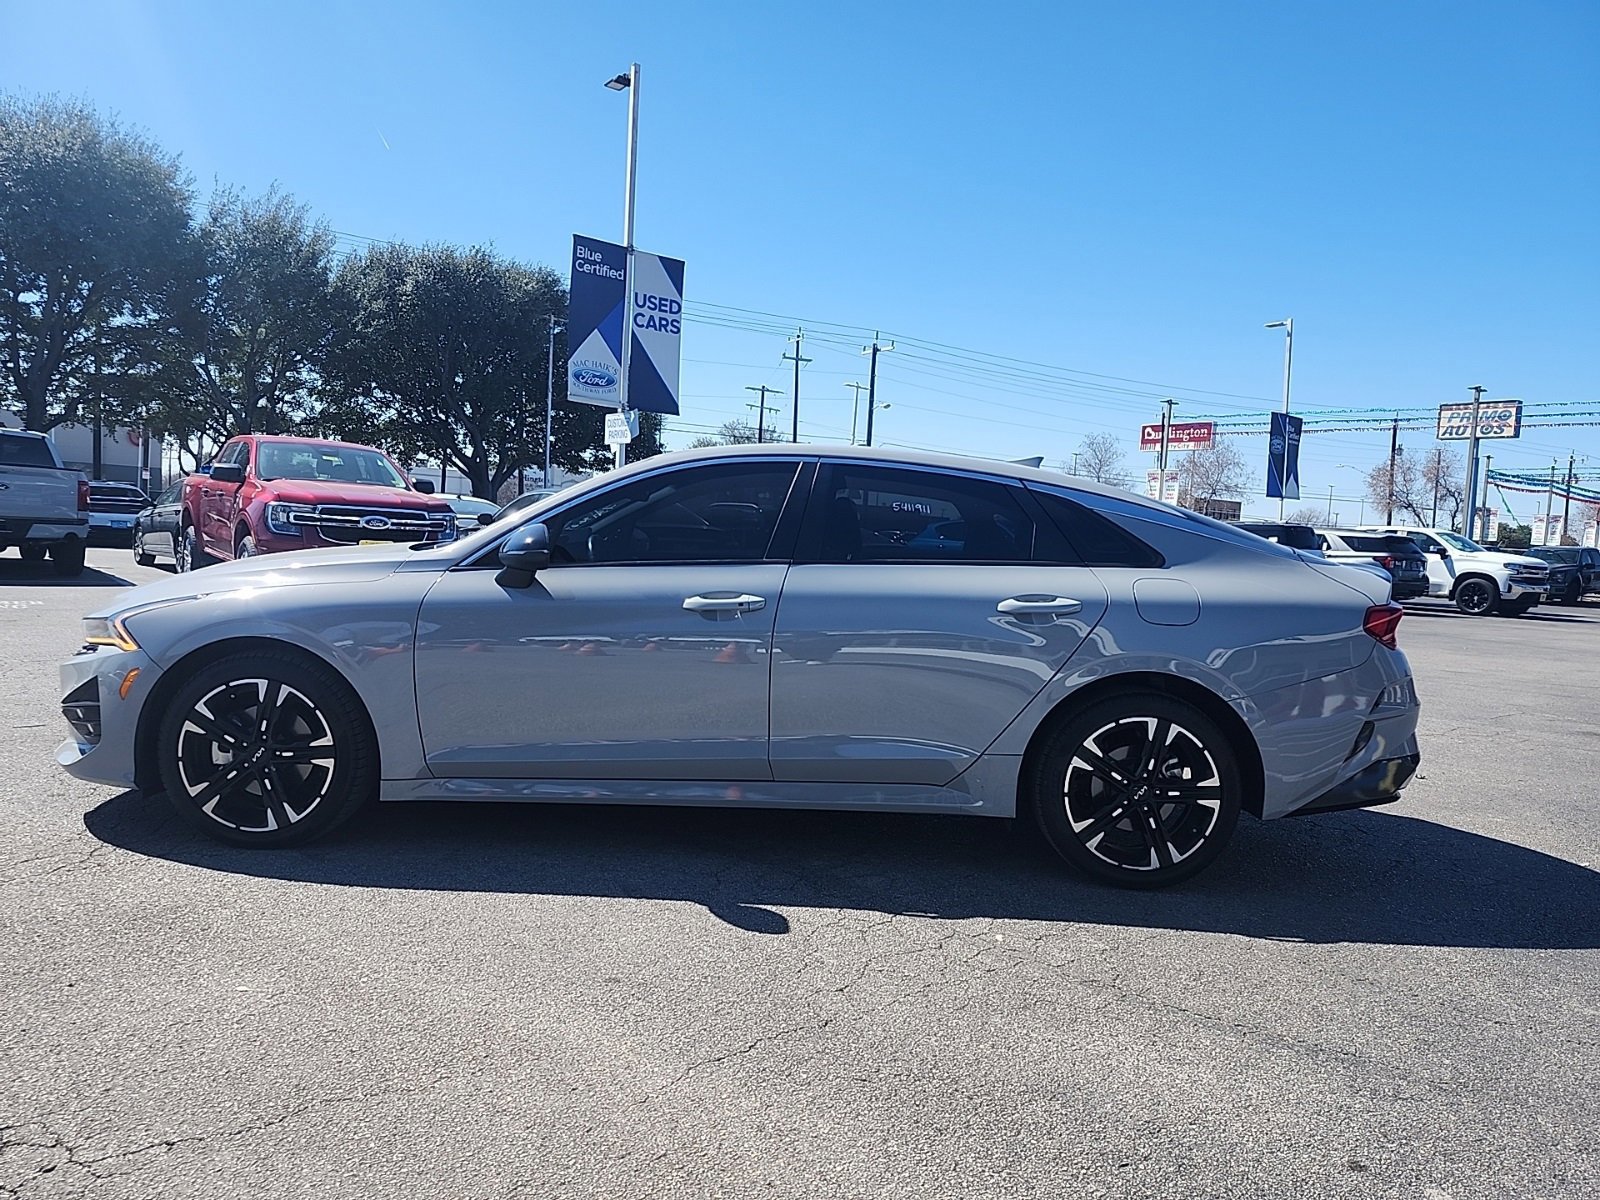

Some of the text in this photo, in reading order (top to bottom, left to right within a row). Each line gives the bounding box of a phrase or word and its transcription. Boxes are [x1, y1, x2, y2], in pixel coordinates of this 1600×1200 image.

[576, 246, 603, 262] Blue
[575, 260, 625, 281] Certified
[634, 291, 682, 315] USED
[633, 312, 681, 334] CARS
[572, 359, 590, 368] MAC
[579, 369, 609, 386] Ford
[1447, 409, 1513, 424] PRMO
[1144, 427, 1208, 442] Bulington
[892, 501, 931, 514] 5411911
[369, 519, 385, 527] Ford
